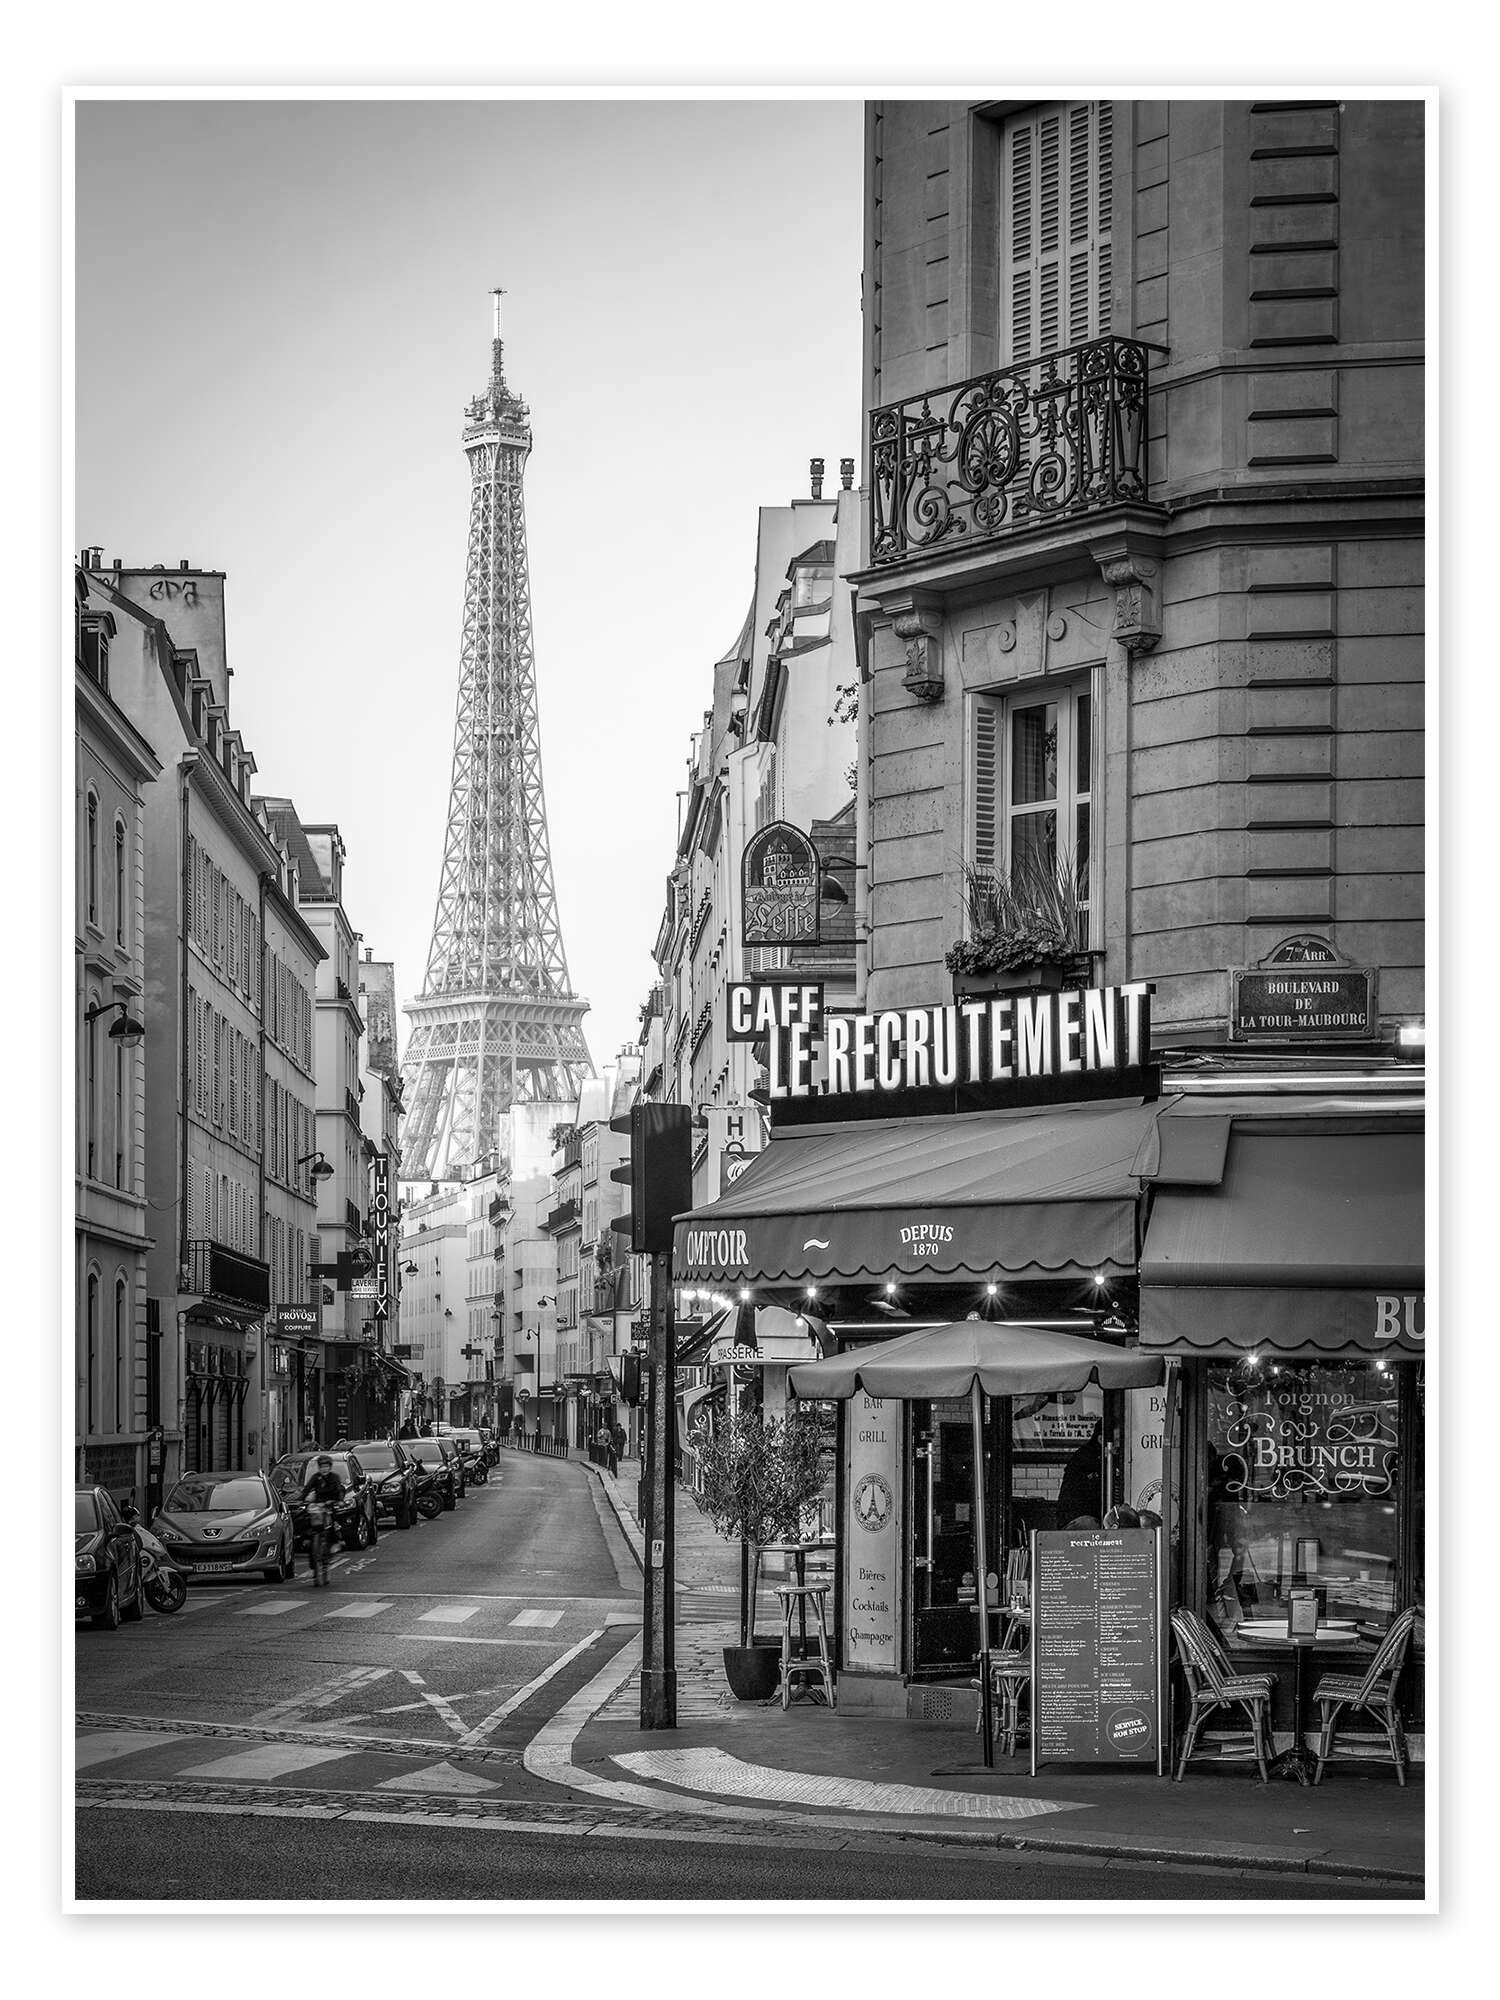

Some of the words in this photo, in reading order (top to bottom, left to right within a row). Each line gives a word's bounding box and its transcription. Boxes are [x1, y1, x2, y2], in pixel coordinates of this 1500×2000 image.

[746, 902, 815, 938] Leffe
[1268, 981, 1339, 994] BOULEVARD
[1295, 998, 1313, 1010] DE
[1240, 1016, 1256, 1028] LA
[1259, 1013, 1367, 1027] TOUR-MAUBOURG
[769, 1022, 809, 1098] LE
[828, 982, 1151, 1095] RECRUTEMENT
[900, 1224, 954, 1244] DEPUIS
[913, 1243, 939, 1256] 1870
[352, 1279, 379, 1287] LAVERIE
[279, 1311, 317, 1320] PROVOST
[1374, 1295, 1426, 1341] BU
[863, 1397, 883, 1409] BAR
[859, 1431, 887, 1443] GRILL
[1253, 1437, 1376, 1468] BRUNCH
[859, 1567, 886, 1581] Bières
[852, 1597, 889, 1612] Cocktails
[850, 1626, 893, 1649] Champagne
[1113, 1730, 1128, 1739] NON
[1129, 1725, 1147, 1736] STOP
[1115, 1719, 1143, 1731] SERVICE
